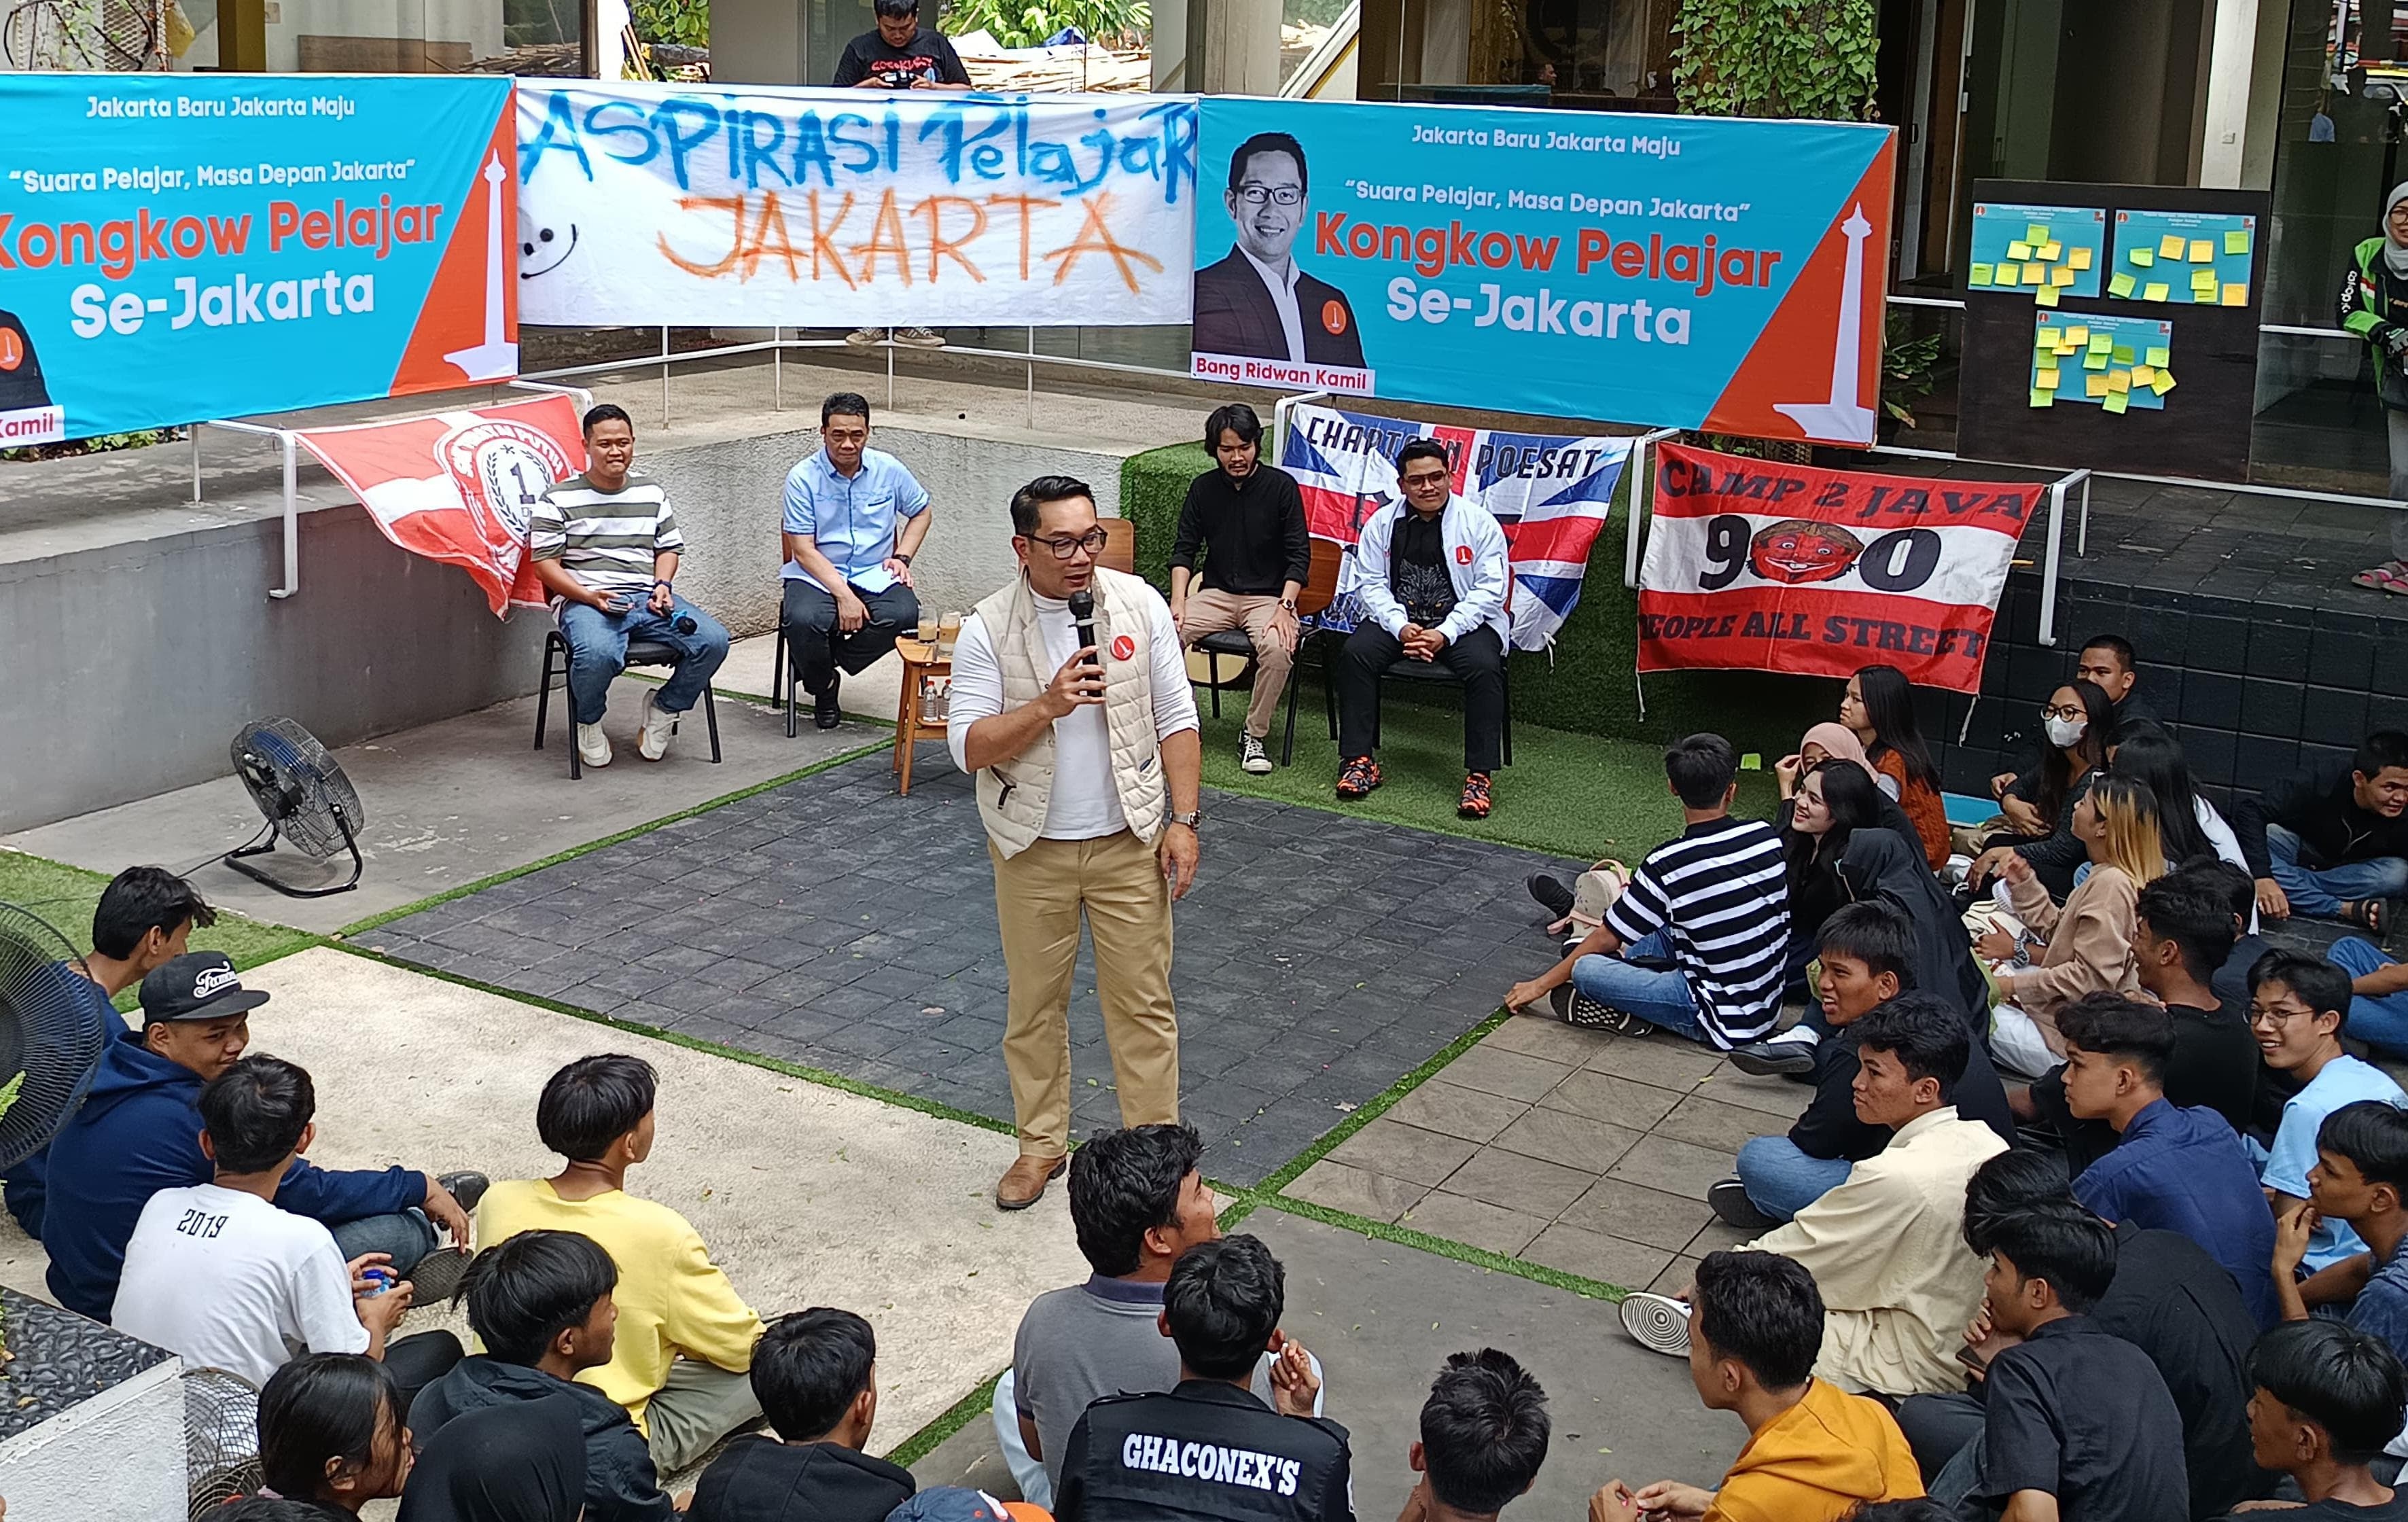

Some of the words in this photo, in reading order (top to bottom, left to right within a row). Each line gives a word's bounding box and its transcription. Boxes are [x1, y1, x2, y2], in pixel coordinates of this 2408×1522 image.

[86, 97, 171, 118] Jakarta
[177, 97, 225, 117] Baru
[231, 96, 307, 117] Jakarta
[313, 96, 355, 120] Maju
[1411, 125, 1488, 147] Jakarta
[1494, 128, 1540, 147] Baru
[1546, 131, 1625, 152] Jakarta
[1631, 135, 1680, 158] Maju
[103, 166, 191, 192] Pelajar,
[198, 166, 253, 187] Masa
[260, 163, 326, 188] Depan
[1421, 185, 1500, 211] Pelajar,
[1508, 189, 1564, 212] Masa
[1570, 193, 1642, 219] Depan
[270, 194, 443, 261] Pelajar
[657, 186, 1163, 294] JAKARTA
[1315, 211, 1560, 277] Kongkow
[1576, 228, 1783, 296] Pelajar
[70, 270, 374, 340] Se-Jakarta
[1386, 277, 1692, 347] Se-Jakarta
[1197, 358, 1239, 380] Bang
[1244, 362, 1309, 385] Ridwan
[1315, 370, 1366, 389] Kamil
[1474, 444, 1603, 480] POESAT
[1659, 457, 1806, 503] CAMP
[1815, 483, 1850, 510] 2
[1856, 482, 2025, 522] JAVA
[1740, 611, 1811, 641] ALL
[1822, 615, 1985, 659] STREET
[176, 1208, 230, 1238] 2019
[1122, 1433, 1300, 1496] GHACONEX'S
